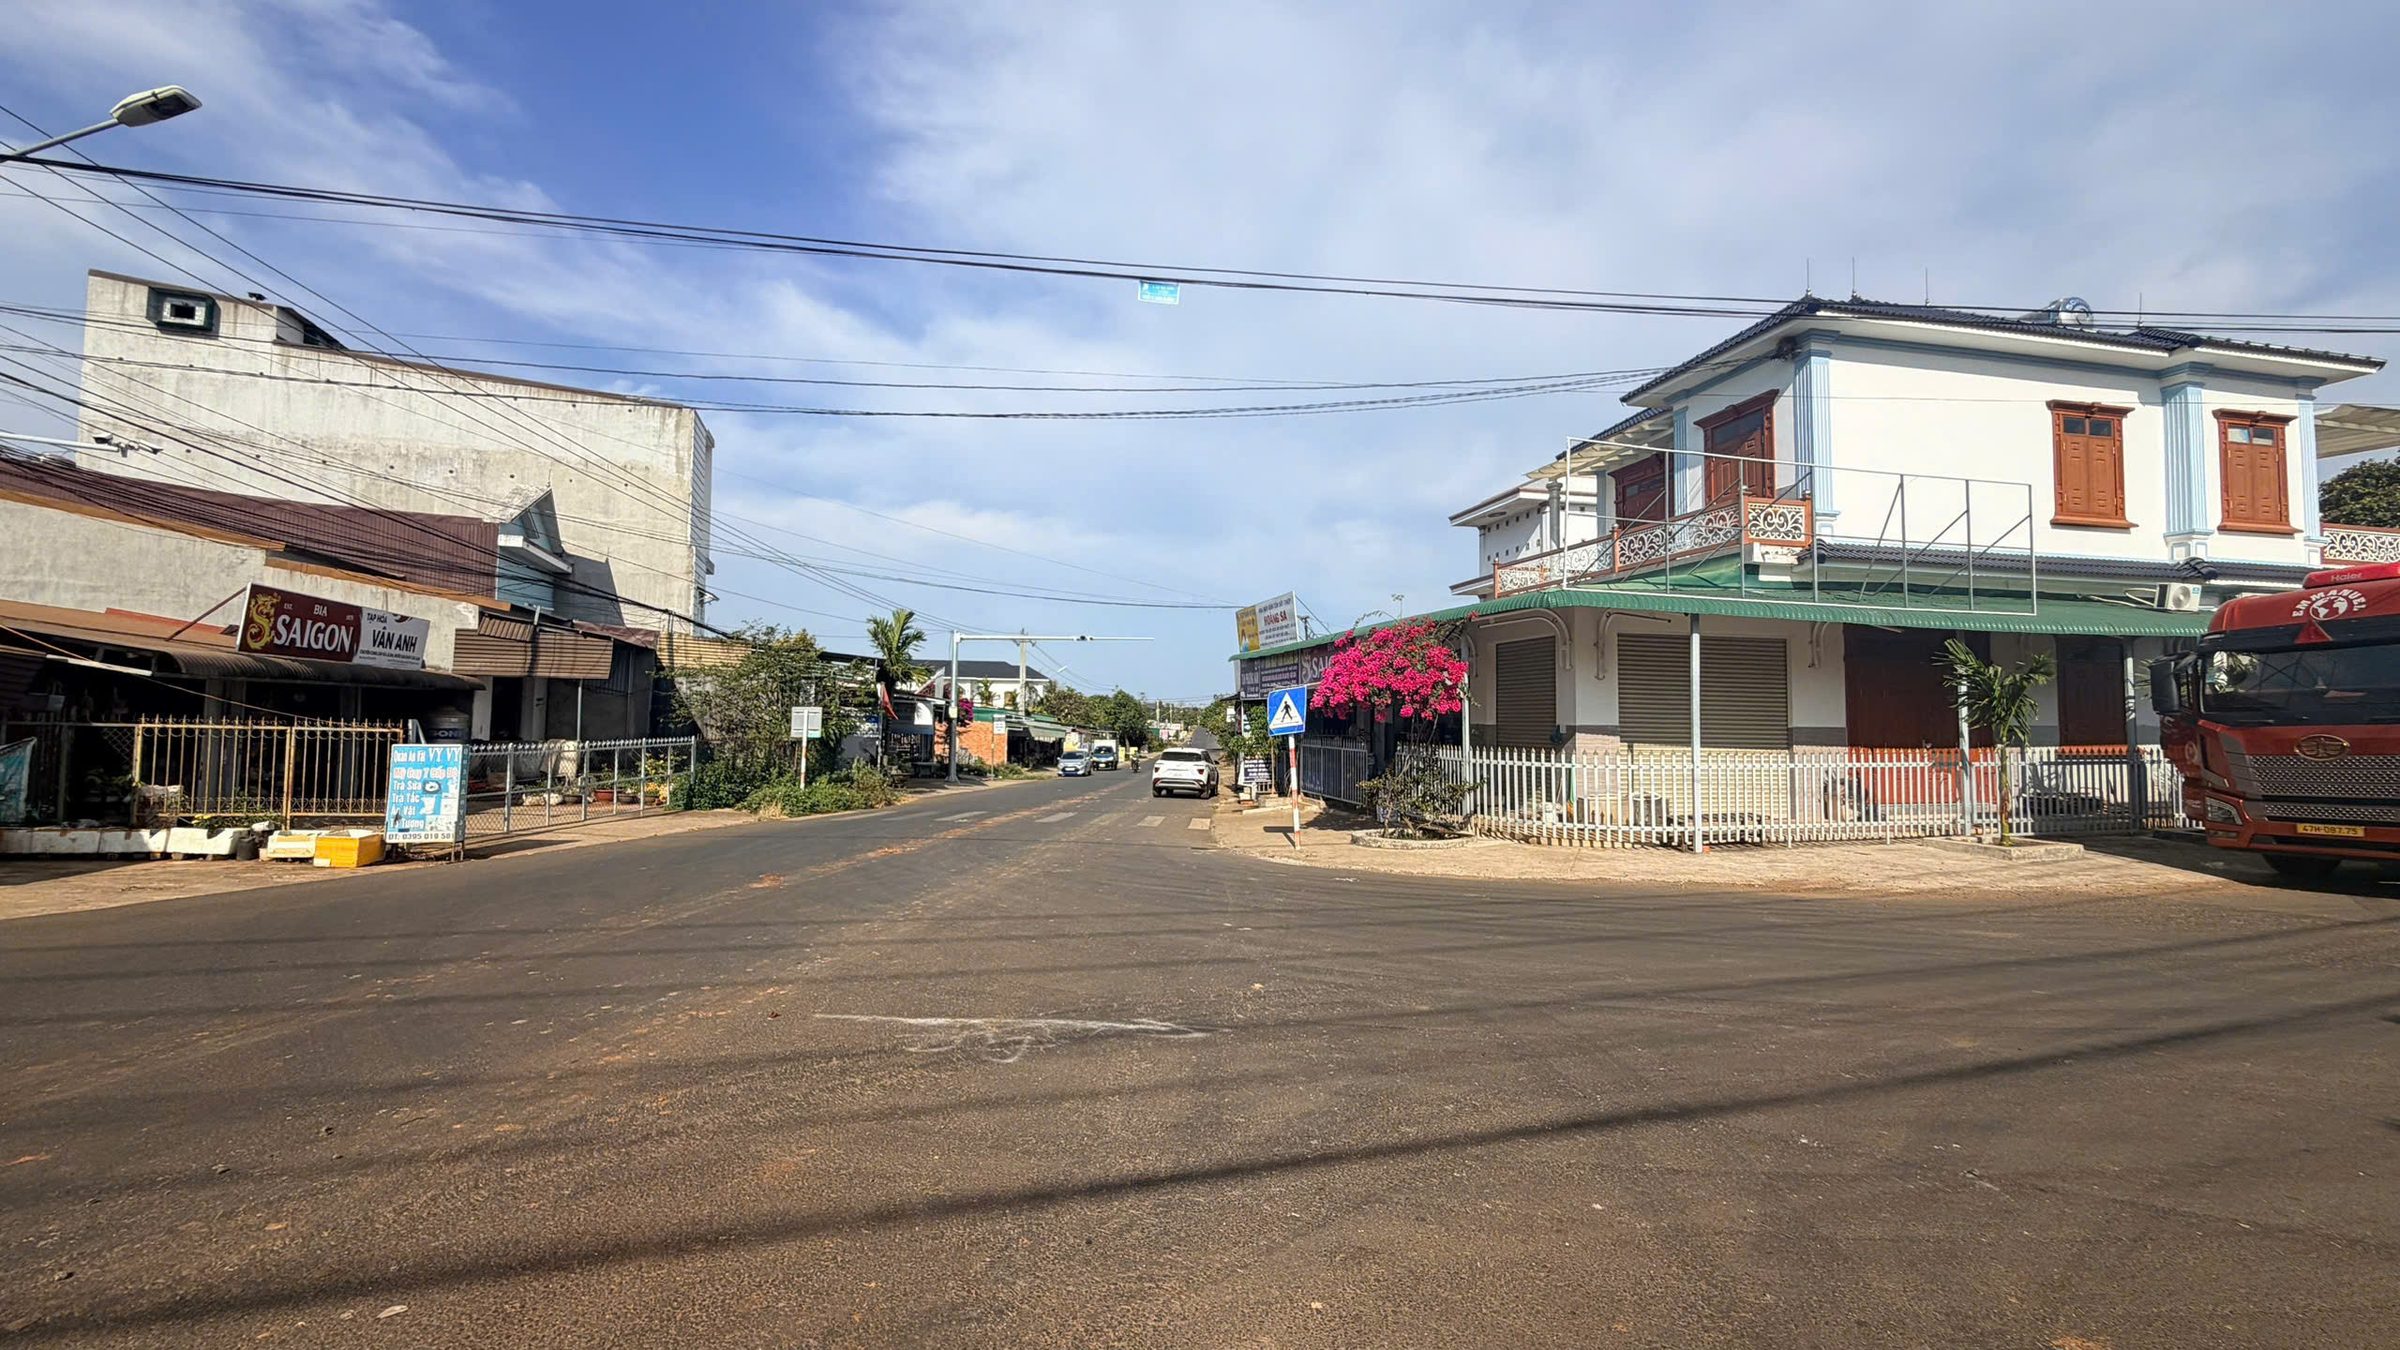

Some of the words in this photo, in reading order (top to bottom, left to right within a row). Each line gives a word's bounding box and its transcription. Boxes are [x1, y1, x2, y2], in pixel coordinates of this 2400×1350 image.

[2330, 573, 2363, 582] Haier
[313, 604, 328, 617] BIA
[2292, 589, 2367, 617] EMMANUEL
[367, 612, 376, 624] TẠP
[274, 615, 354, 653] SAIGON
[372, 626, 395, 650] VÂN
[394, 633, 418, 653] ANH
